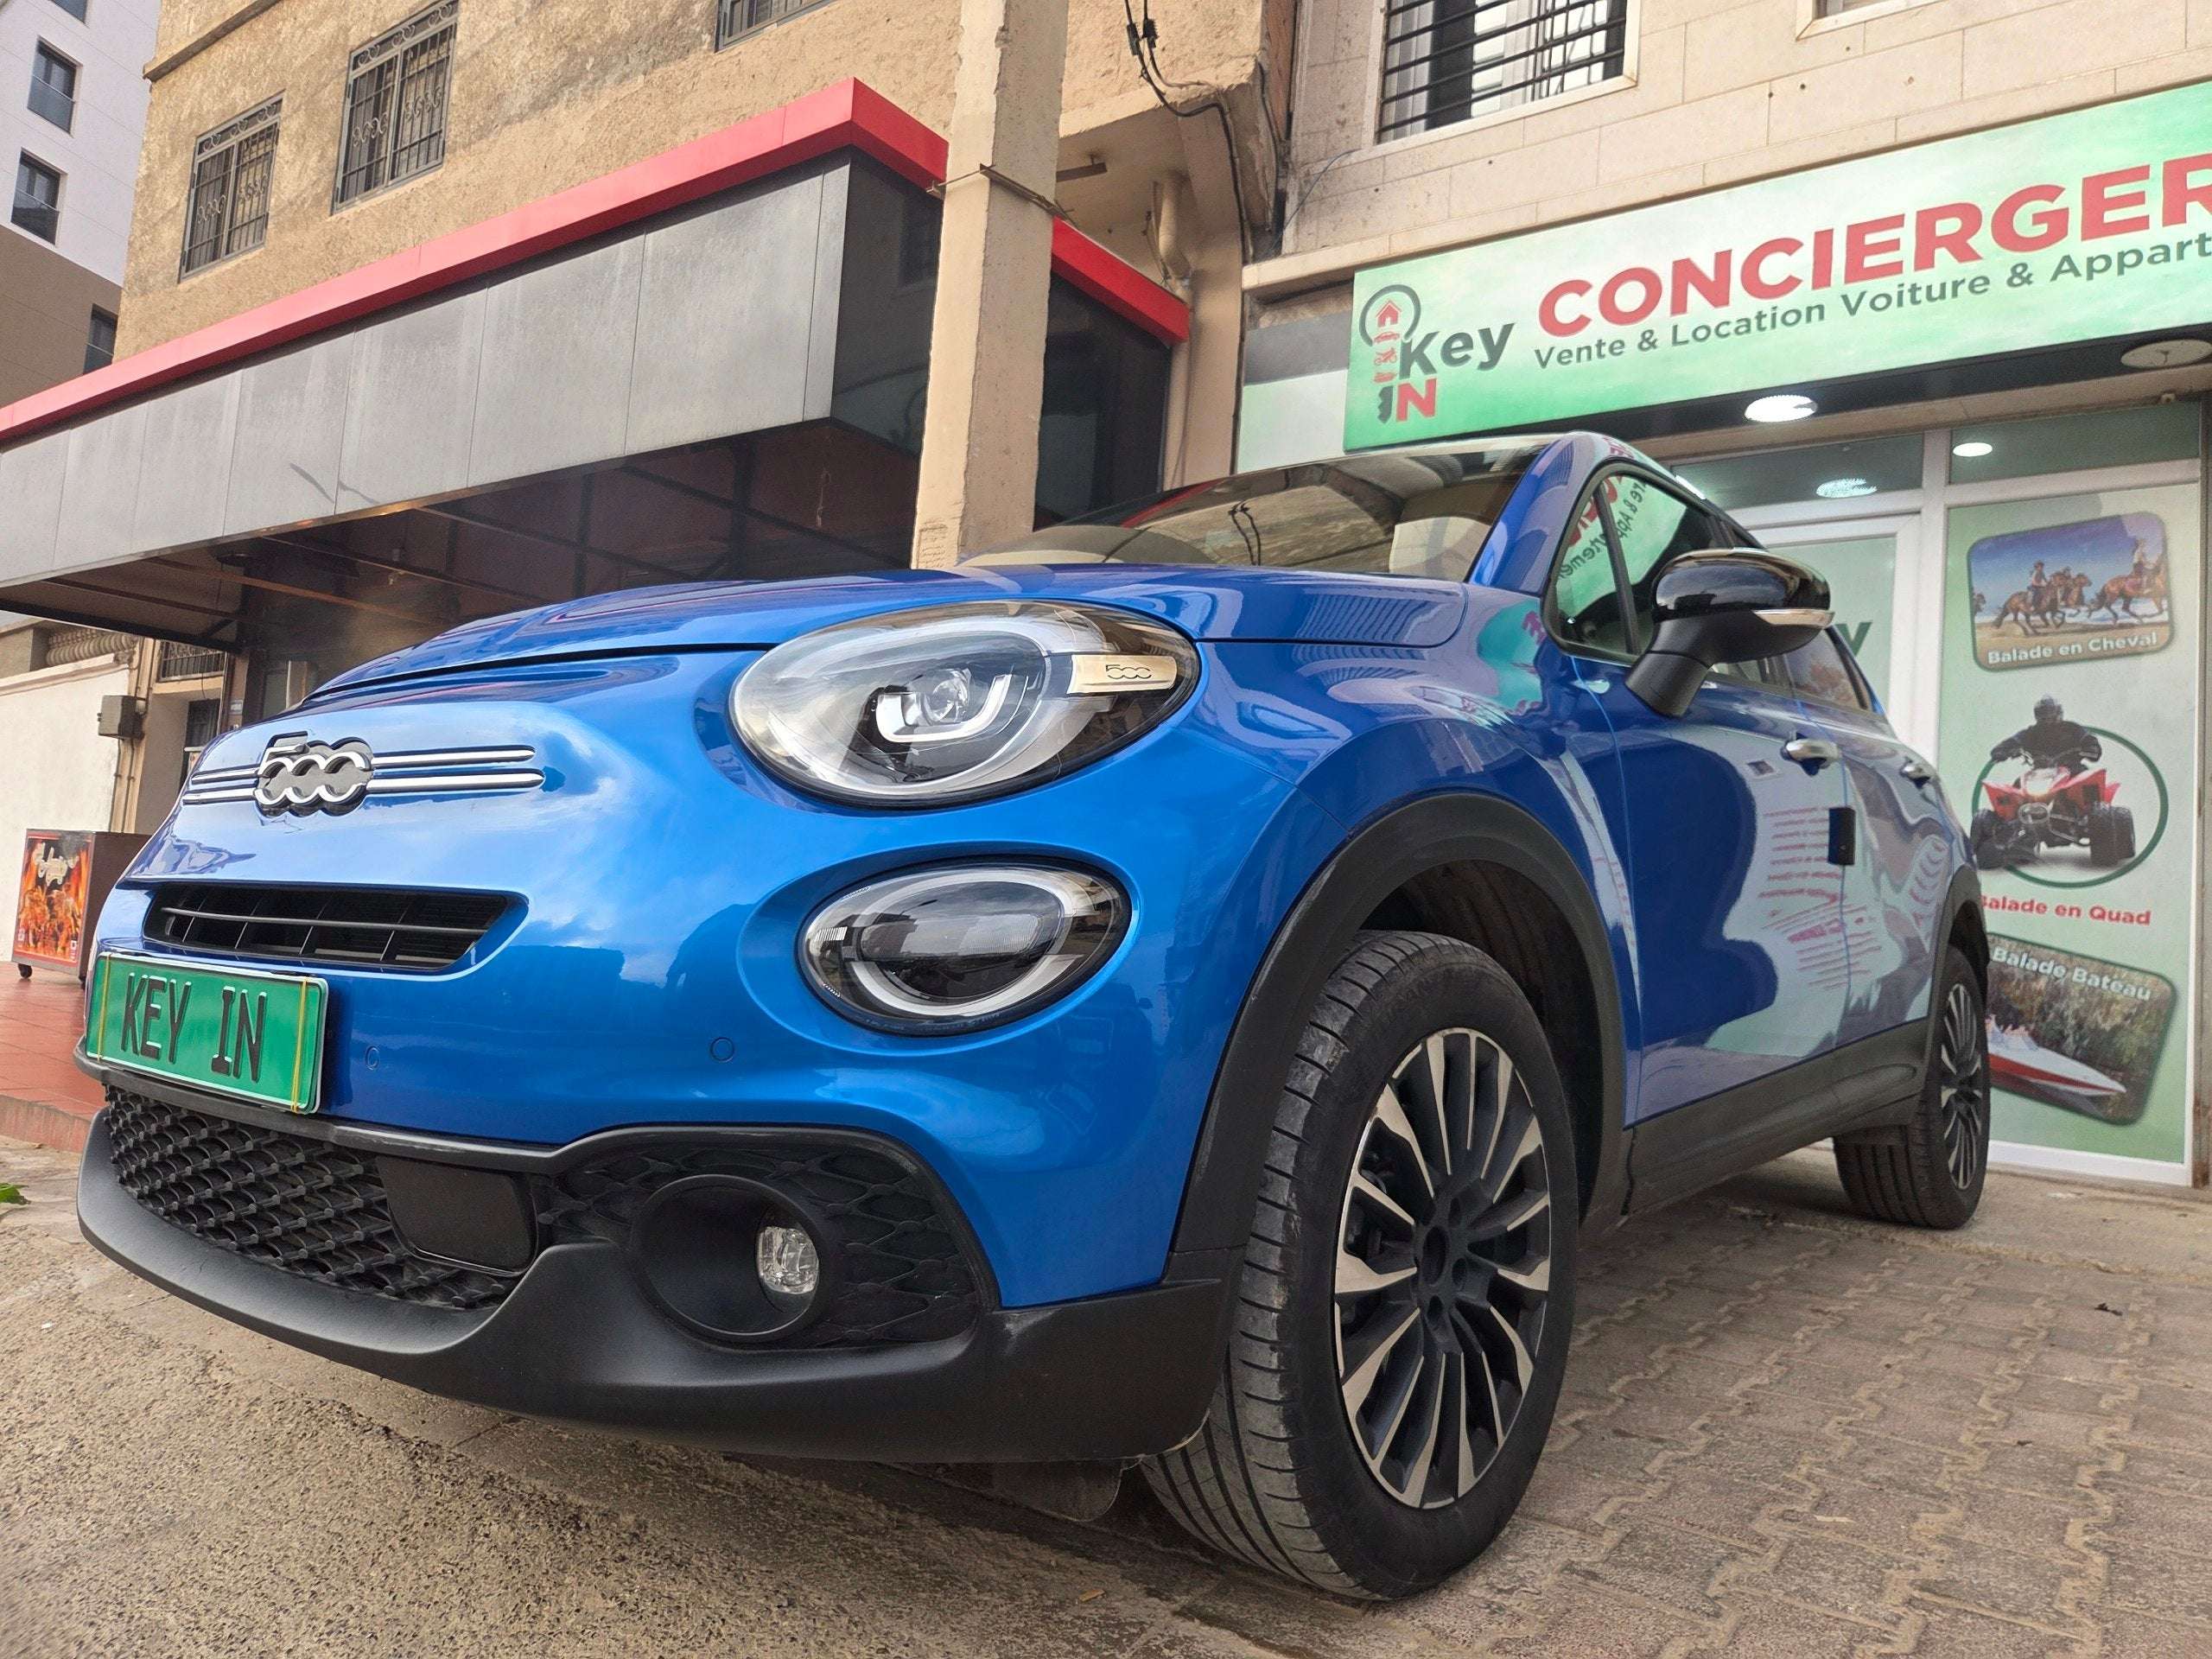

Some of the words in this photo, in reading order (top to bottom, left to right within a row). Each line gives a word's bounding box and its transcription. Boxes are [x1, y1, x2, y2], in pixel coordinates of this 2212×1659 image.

[1535, 338, 1625, 369] Vente
[1637, 328, 1658, 352] &
[1671, 303, 1826, 347] Location
[1841, 273, 1991, 317] Voiture
[2006, 262, 2034, 288] &
[1399, 322, 1516, 380] Key
[1105, 664, 1153, 680] 500
[1987, 645, 2053, 664] Balade
[2058, 643, 2083, 657] en
[2088, 632, 2158, 652] Cheval
[254, 730, 374, 817] 500
[2055, 903, 2082, 918] en
[2088, 905, 2152, 926] Quad
[1991, 946, 2068, 978] Balade
[2071, 966, 2152, 1001] Bateau
[121, 972, 192, 1065] KEY
[211, 985, 268, 1084] IN
